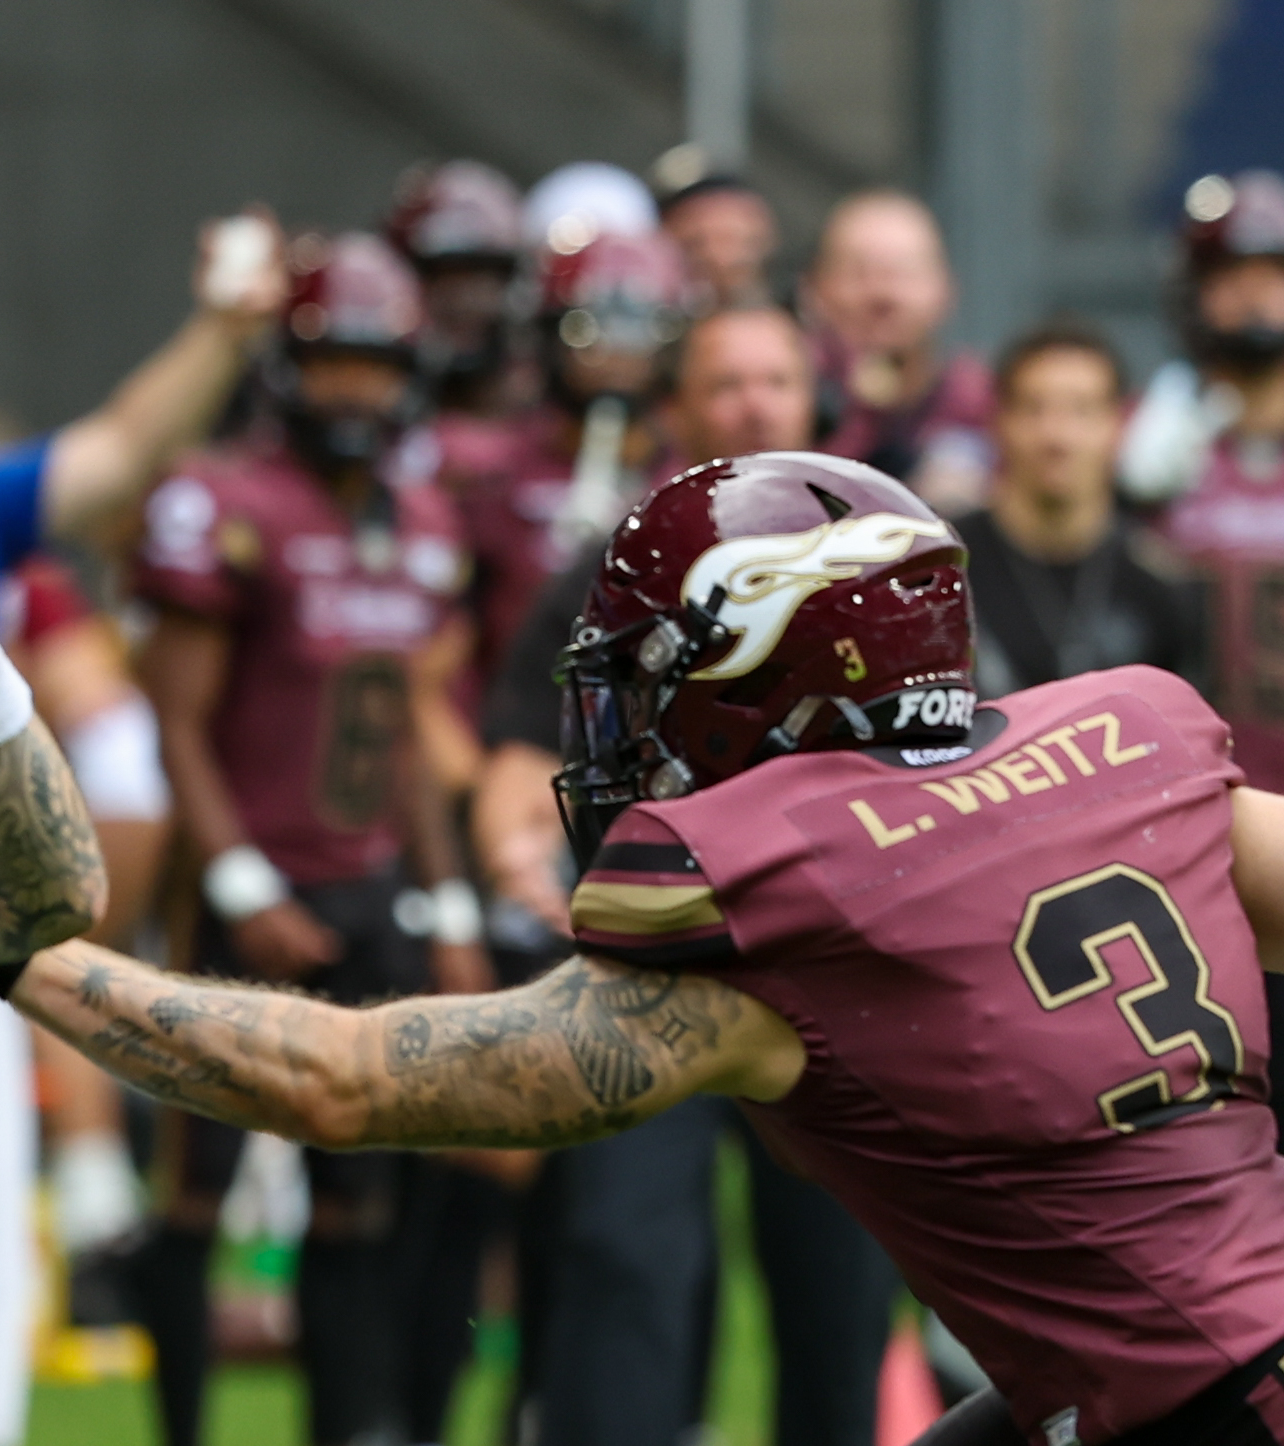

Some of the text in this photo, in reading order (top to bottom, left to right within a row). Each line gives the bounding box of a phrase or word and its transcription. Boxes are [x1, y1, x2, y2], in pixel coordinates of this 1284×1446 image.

[833, 637, 867, 682] 3
[847, 711, 1149, 849] L. WEITZ
[1012, 862, 1245, 1134] 3
